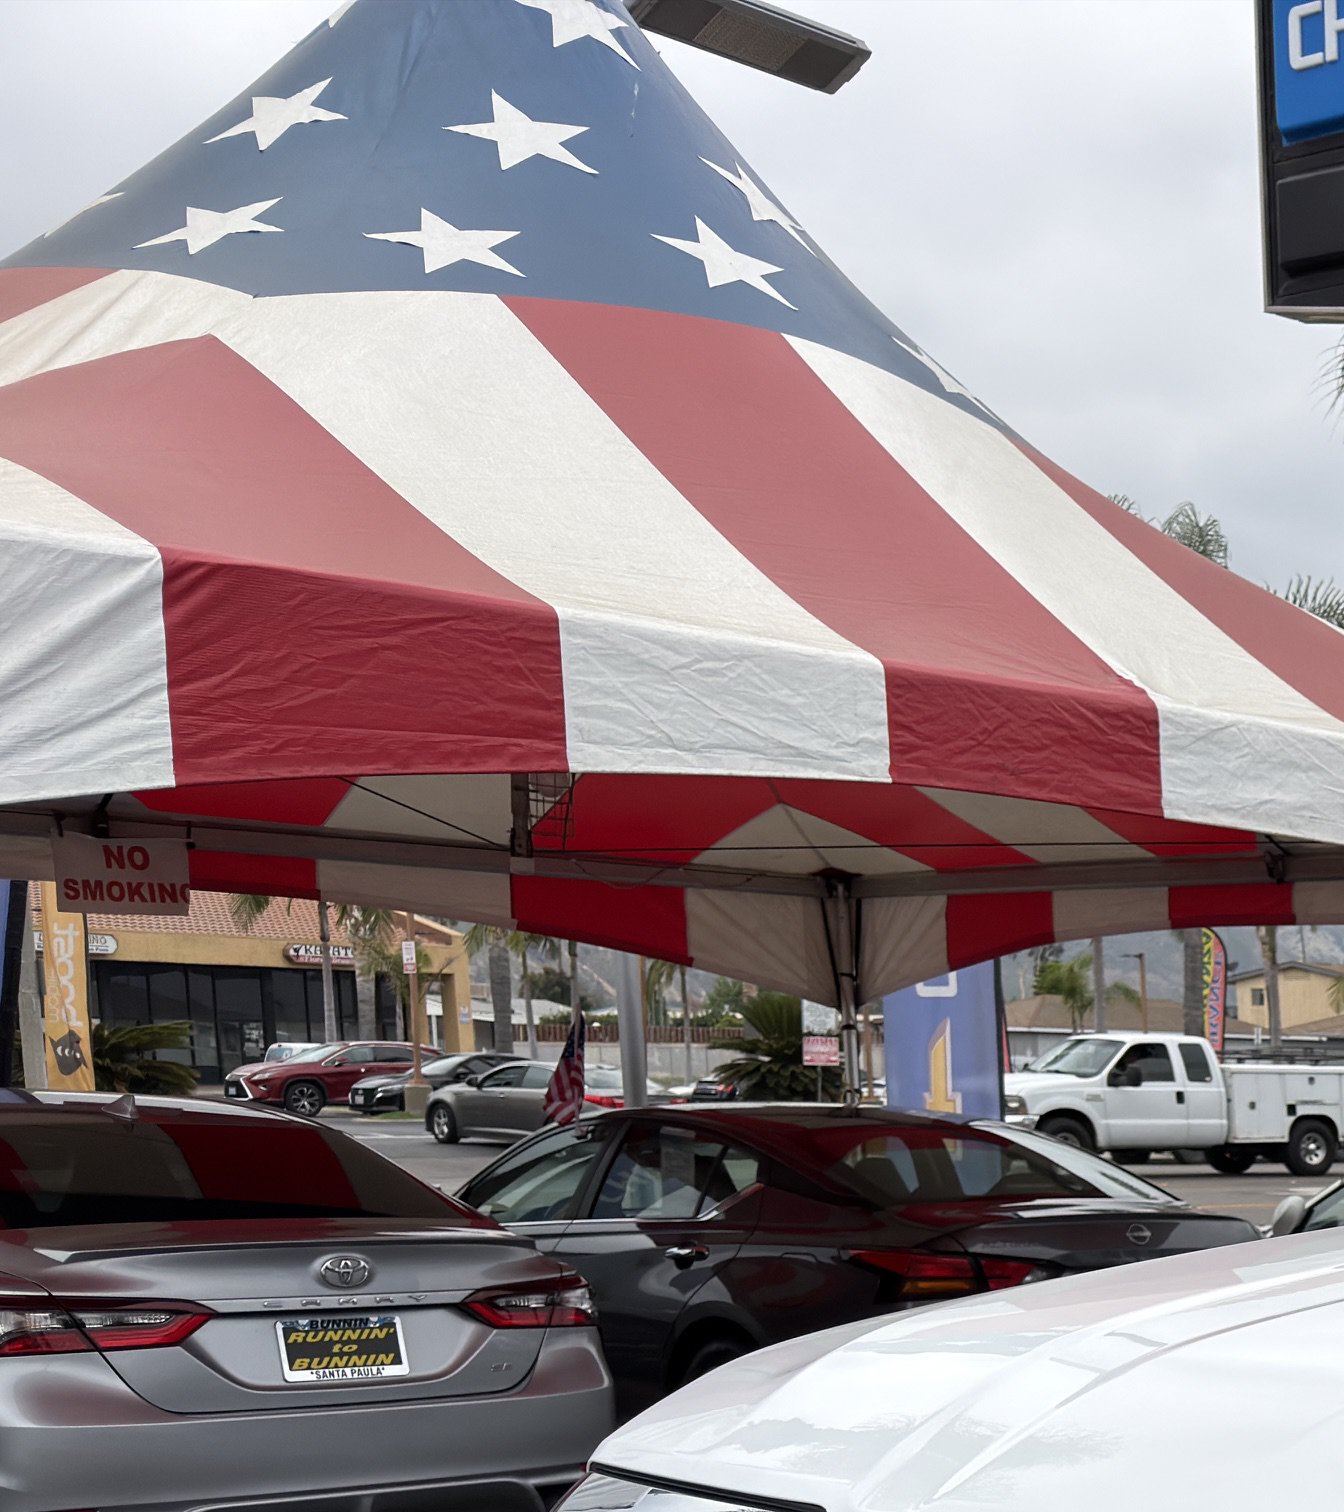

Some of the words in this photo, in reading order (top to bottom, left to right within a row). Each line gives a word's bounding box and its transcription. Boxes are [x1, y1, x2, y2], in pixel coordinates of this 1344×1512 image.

[101, 844, 151, 871] NO
[303, 944, 354, 957] KAAT
[309, 1317, 370, 1330] BUNNIN
[287, 1327, 395, 1344] RUNNIN'
[331, 1343, 358, 1353] to
[291, 1353, 395, 1371] BUNNIN
[315, 1369, 348, 1379] SANTA
[350, 1367, 383, 1378] PAULA
